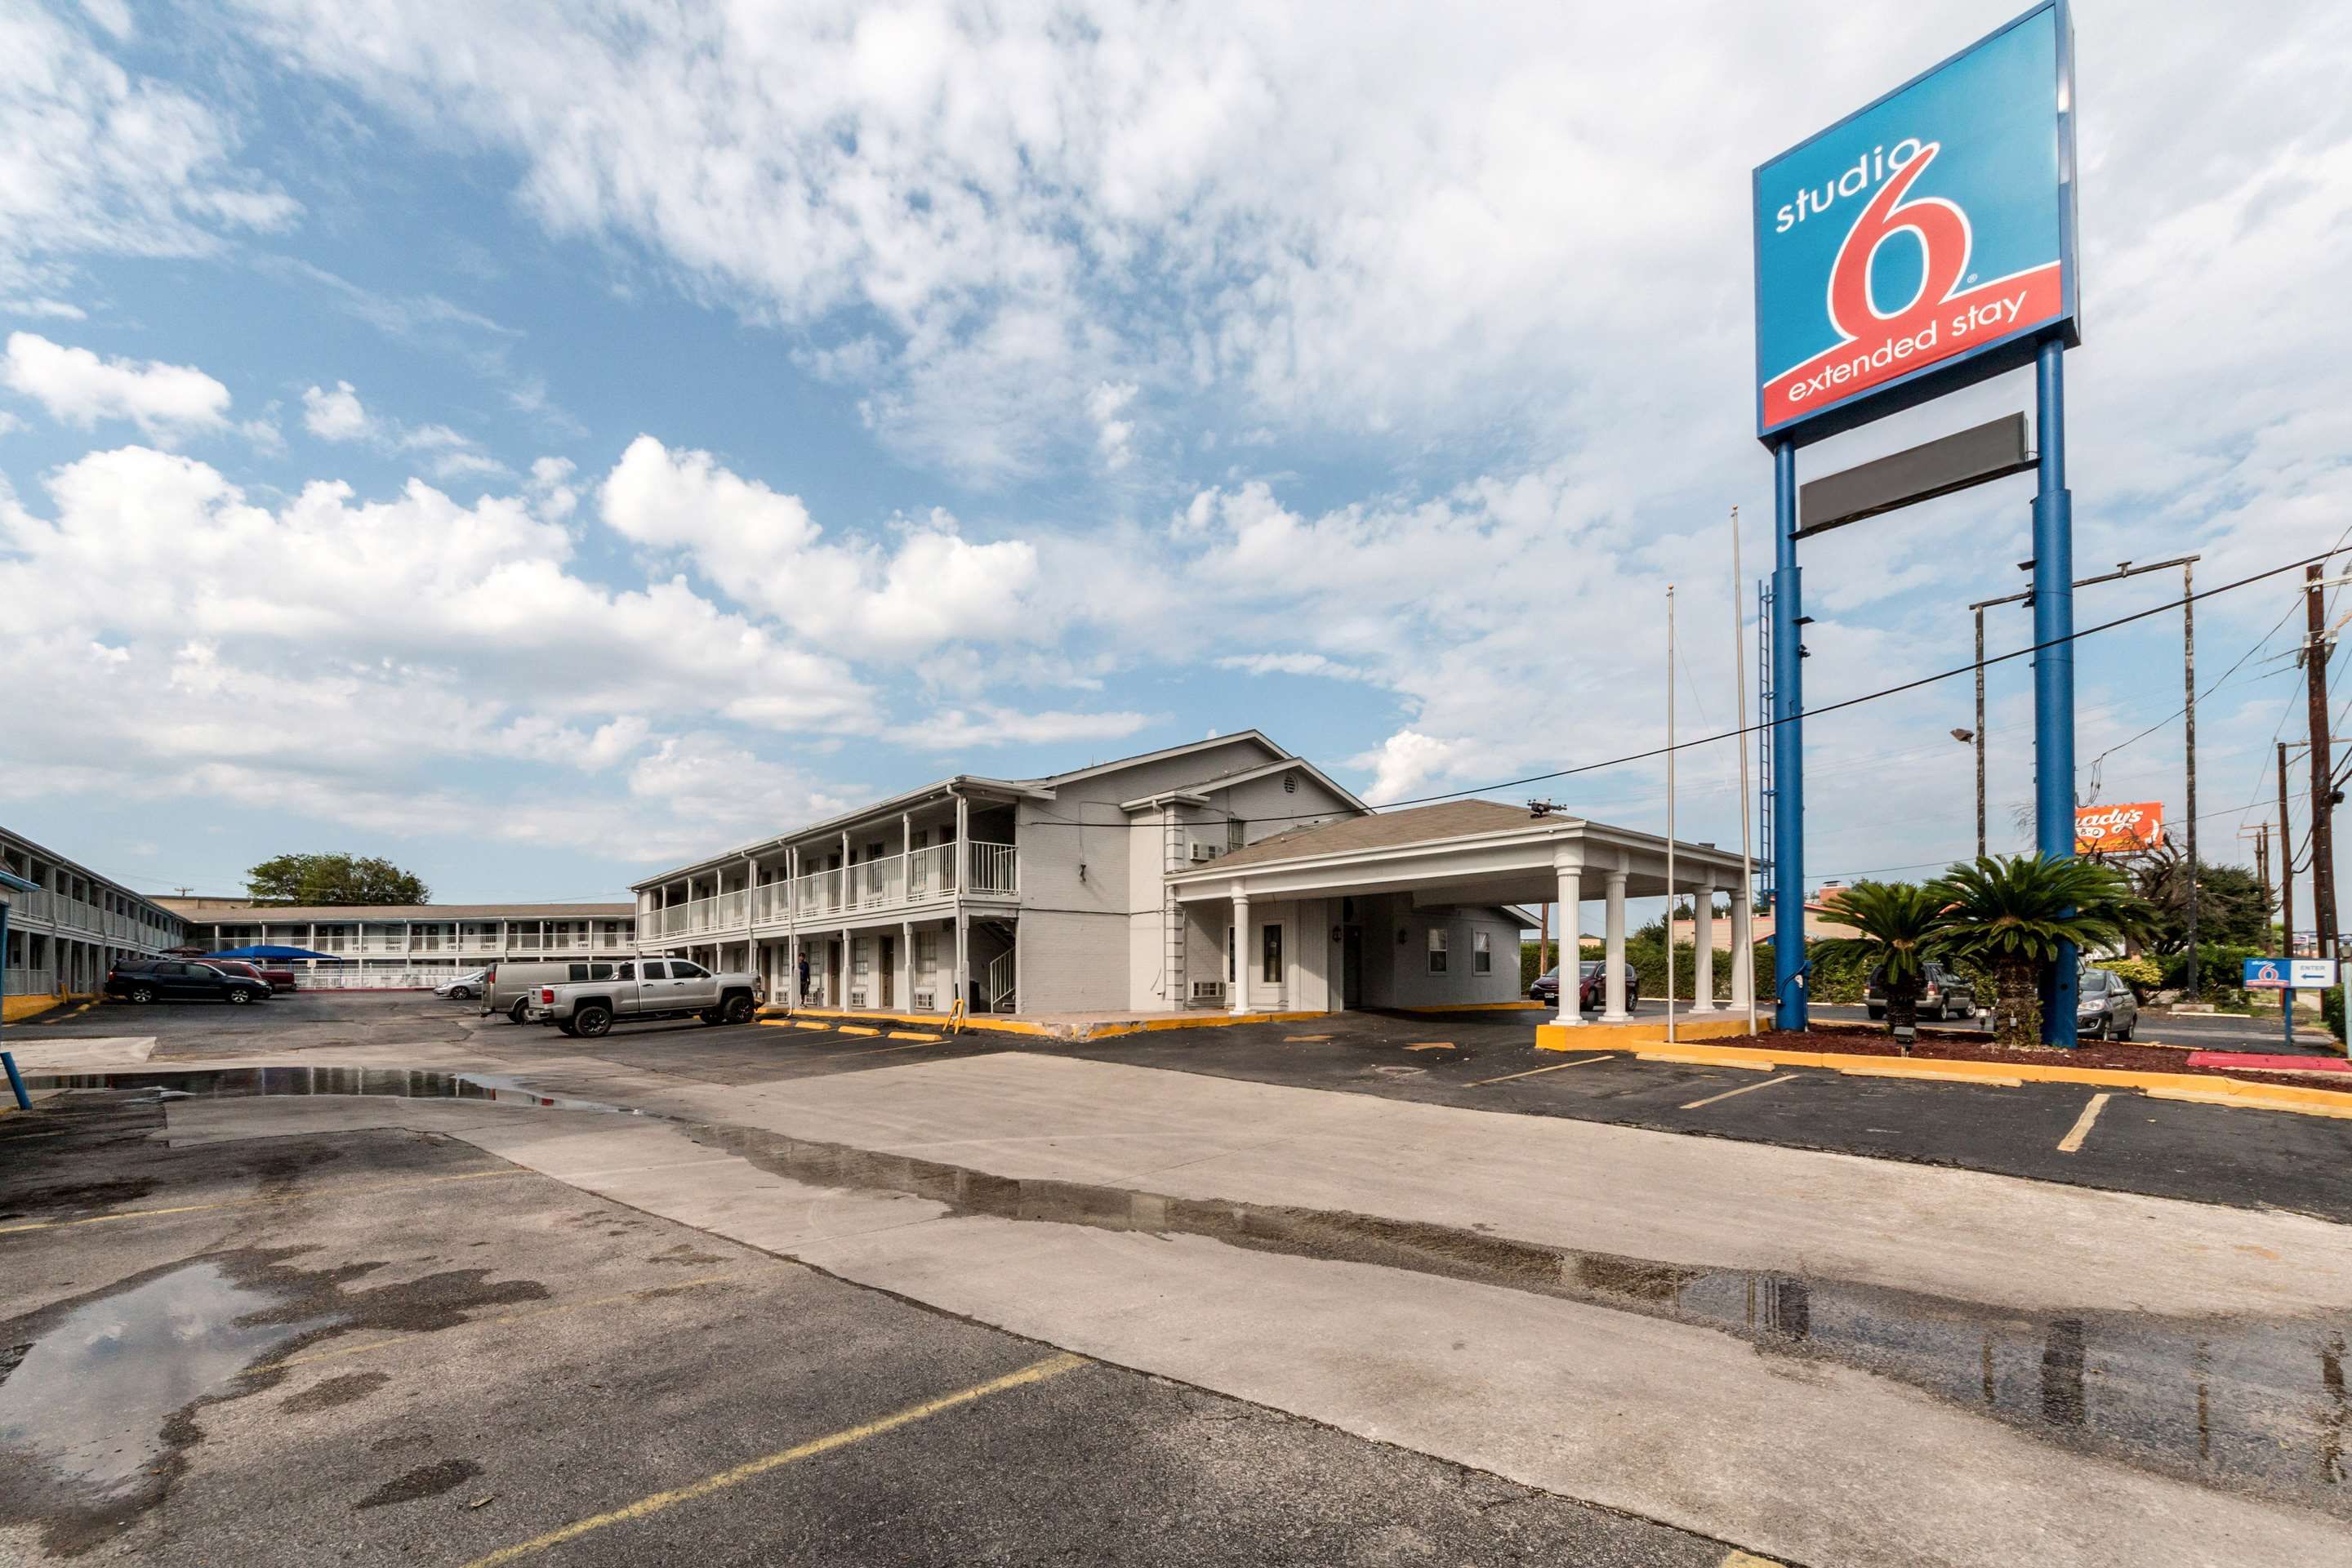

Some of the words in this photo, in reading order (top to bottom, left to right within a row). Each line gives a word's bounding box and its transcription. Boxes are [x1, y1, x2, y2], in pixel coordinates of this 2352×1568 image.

[1775, 137, 1921, 234] studio
[1826, 140, 1973, 341] 6
[1788, 319, 1938, 402] extended
[1951, 290, 2028, 337] stay
[2075, 808, 2144, 834] ady's
